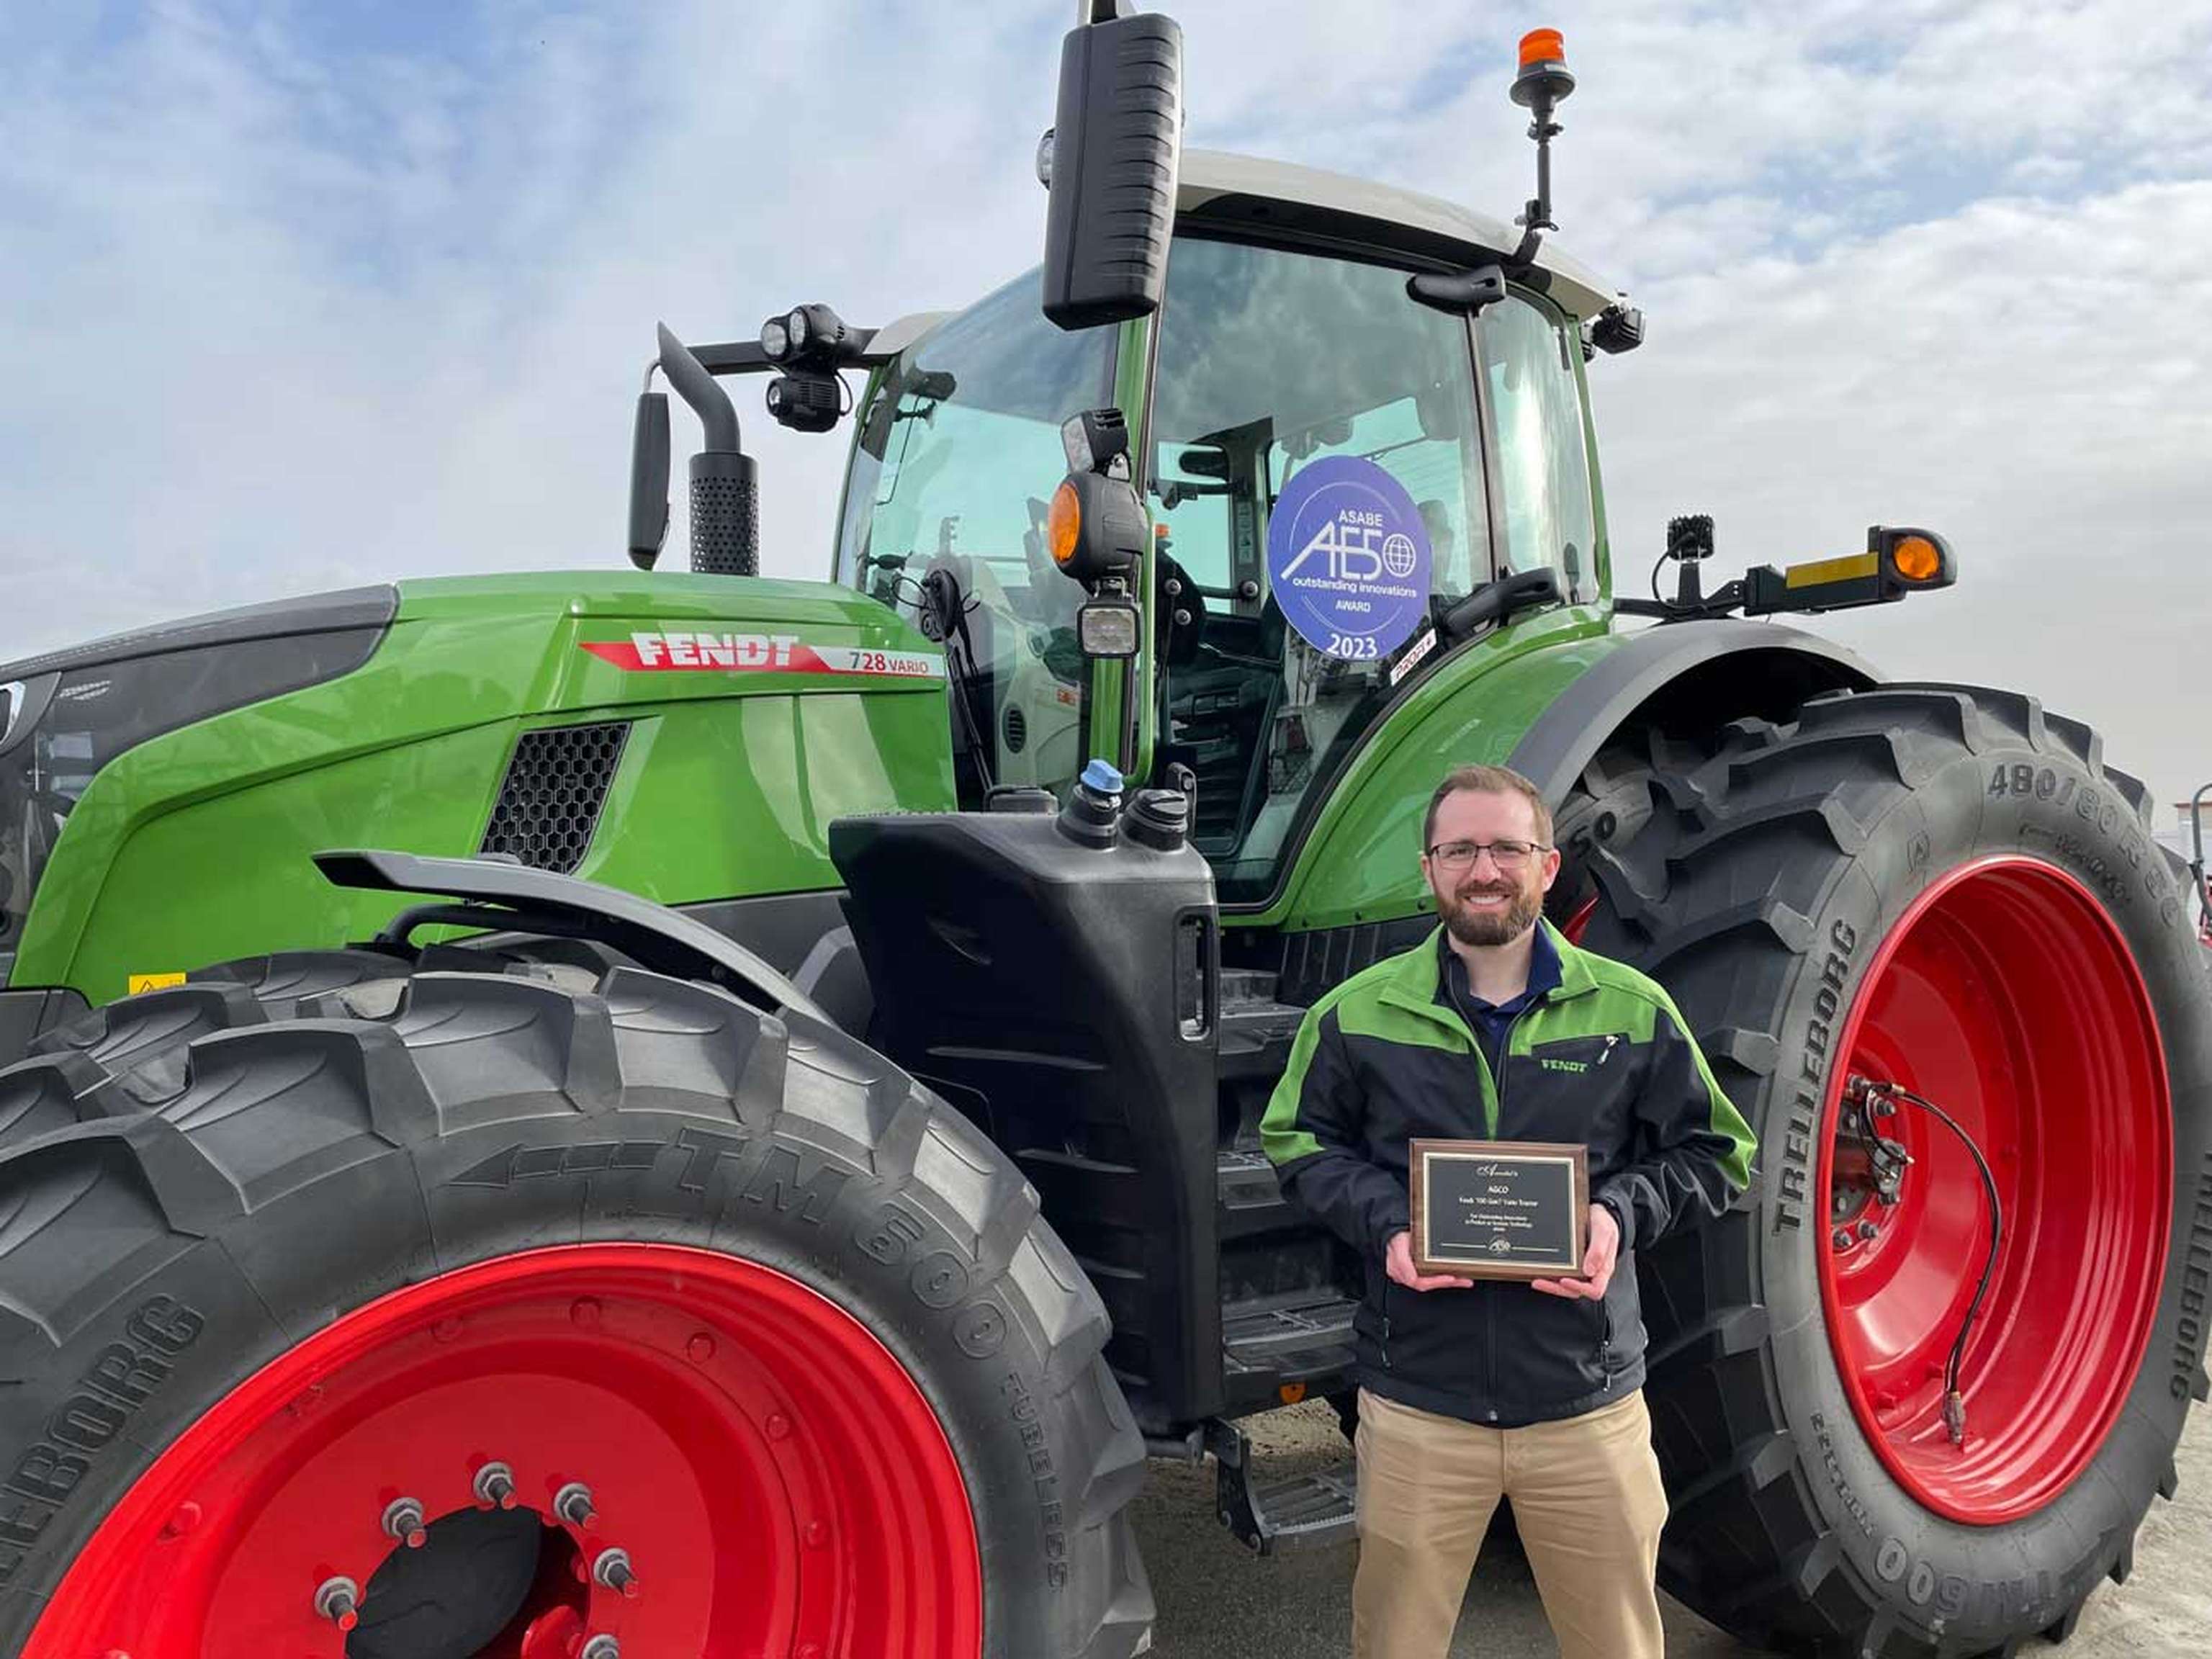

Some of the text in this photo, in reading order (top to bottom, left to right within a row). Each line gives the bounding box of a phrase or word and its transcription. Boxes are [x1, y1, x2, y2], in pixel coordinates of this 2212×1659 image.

[1339, 510, 1383, 526] ASABE
[1292, 576, 1416, 598] outstanding innovations
[1335, 600, 1371, 613] AWARD
[630, 632, 929, 674] FENDT 728 VARIO
[1327, 634, 1378, 658] 2023
[1541, 1059, 1588, 1072] FENDT
[1772, 919, 1858, 1236] TRELLEBORG
[675, 1128, 1007, 1359] TM 600
[2169, 1151, 2212, 1401] RELLEBORG
